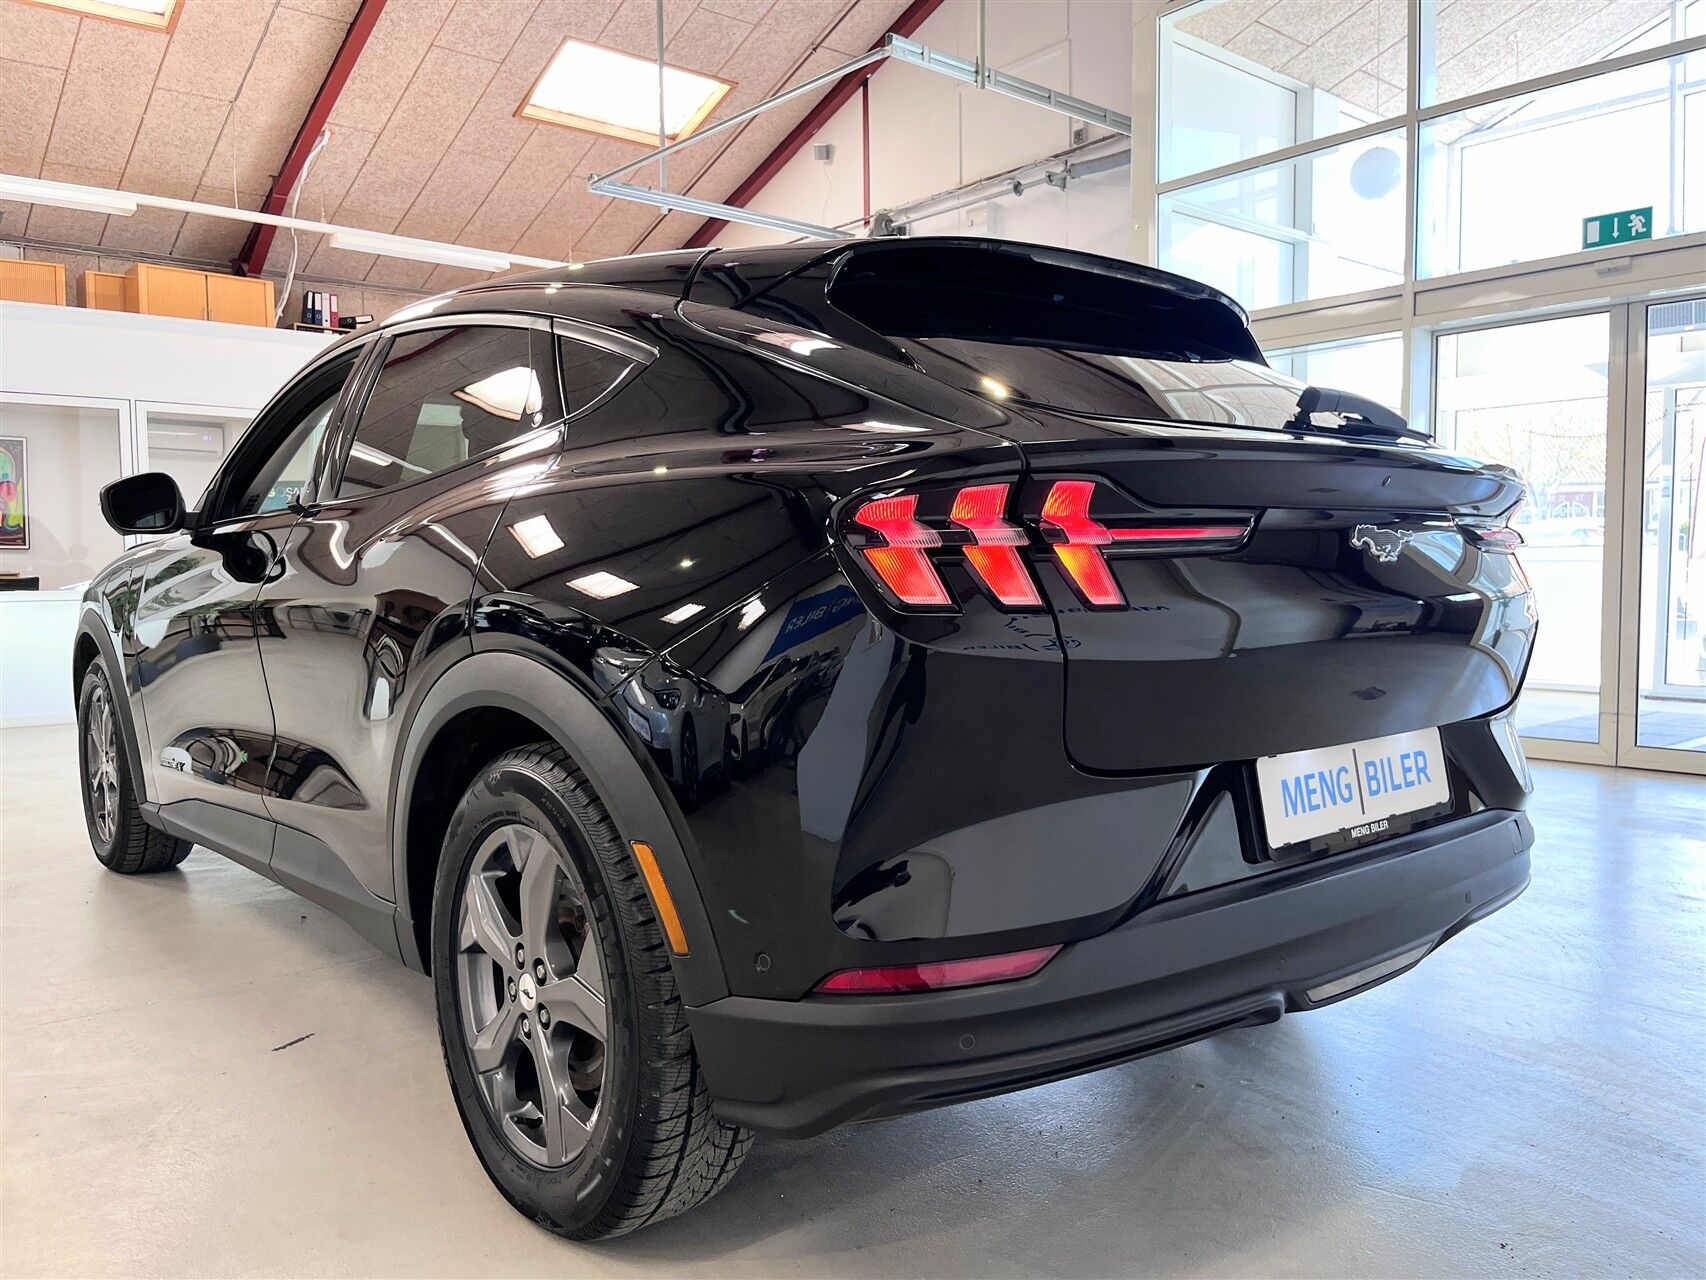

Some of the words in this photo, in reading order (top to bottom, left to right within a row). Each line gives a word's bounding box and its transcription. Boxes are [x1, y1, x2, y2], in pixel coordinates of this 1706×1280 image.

[1280, 765, 1354, 818] MENG
[1364, 750, 1432, 797] BILER
[1350, 825, 1370, 838] MENG
[1370, 820, 1389, 834] BILER
